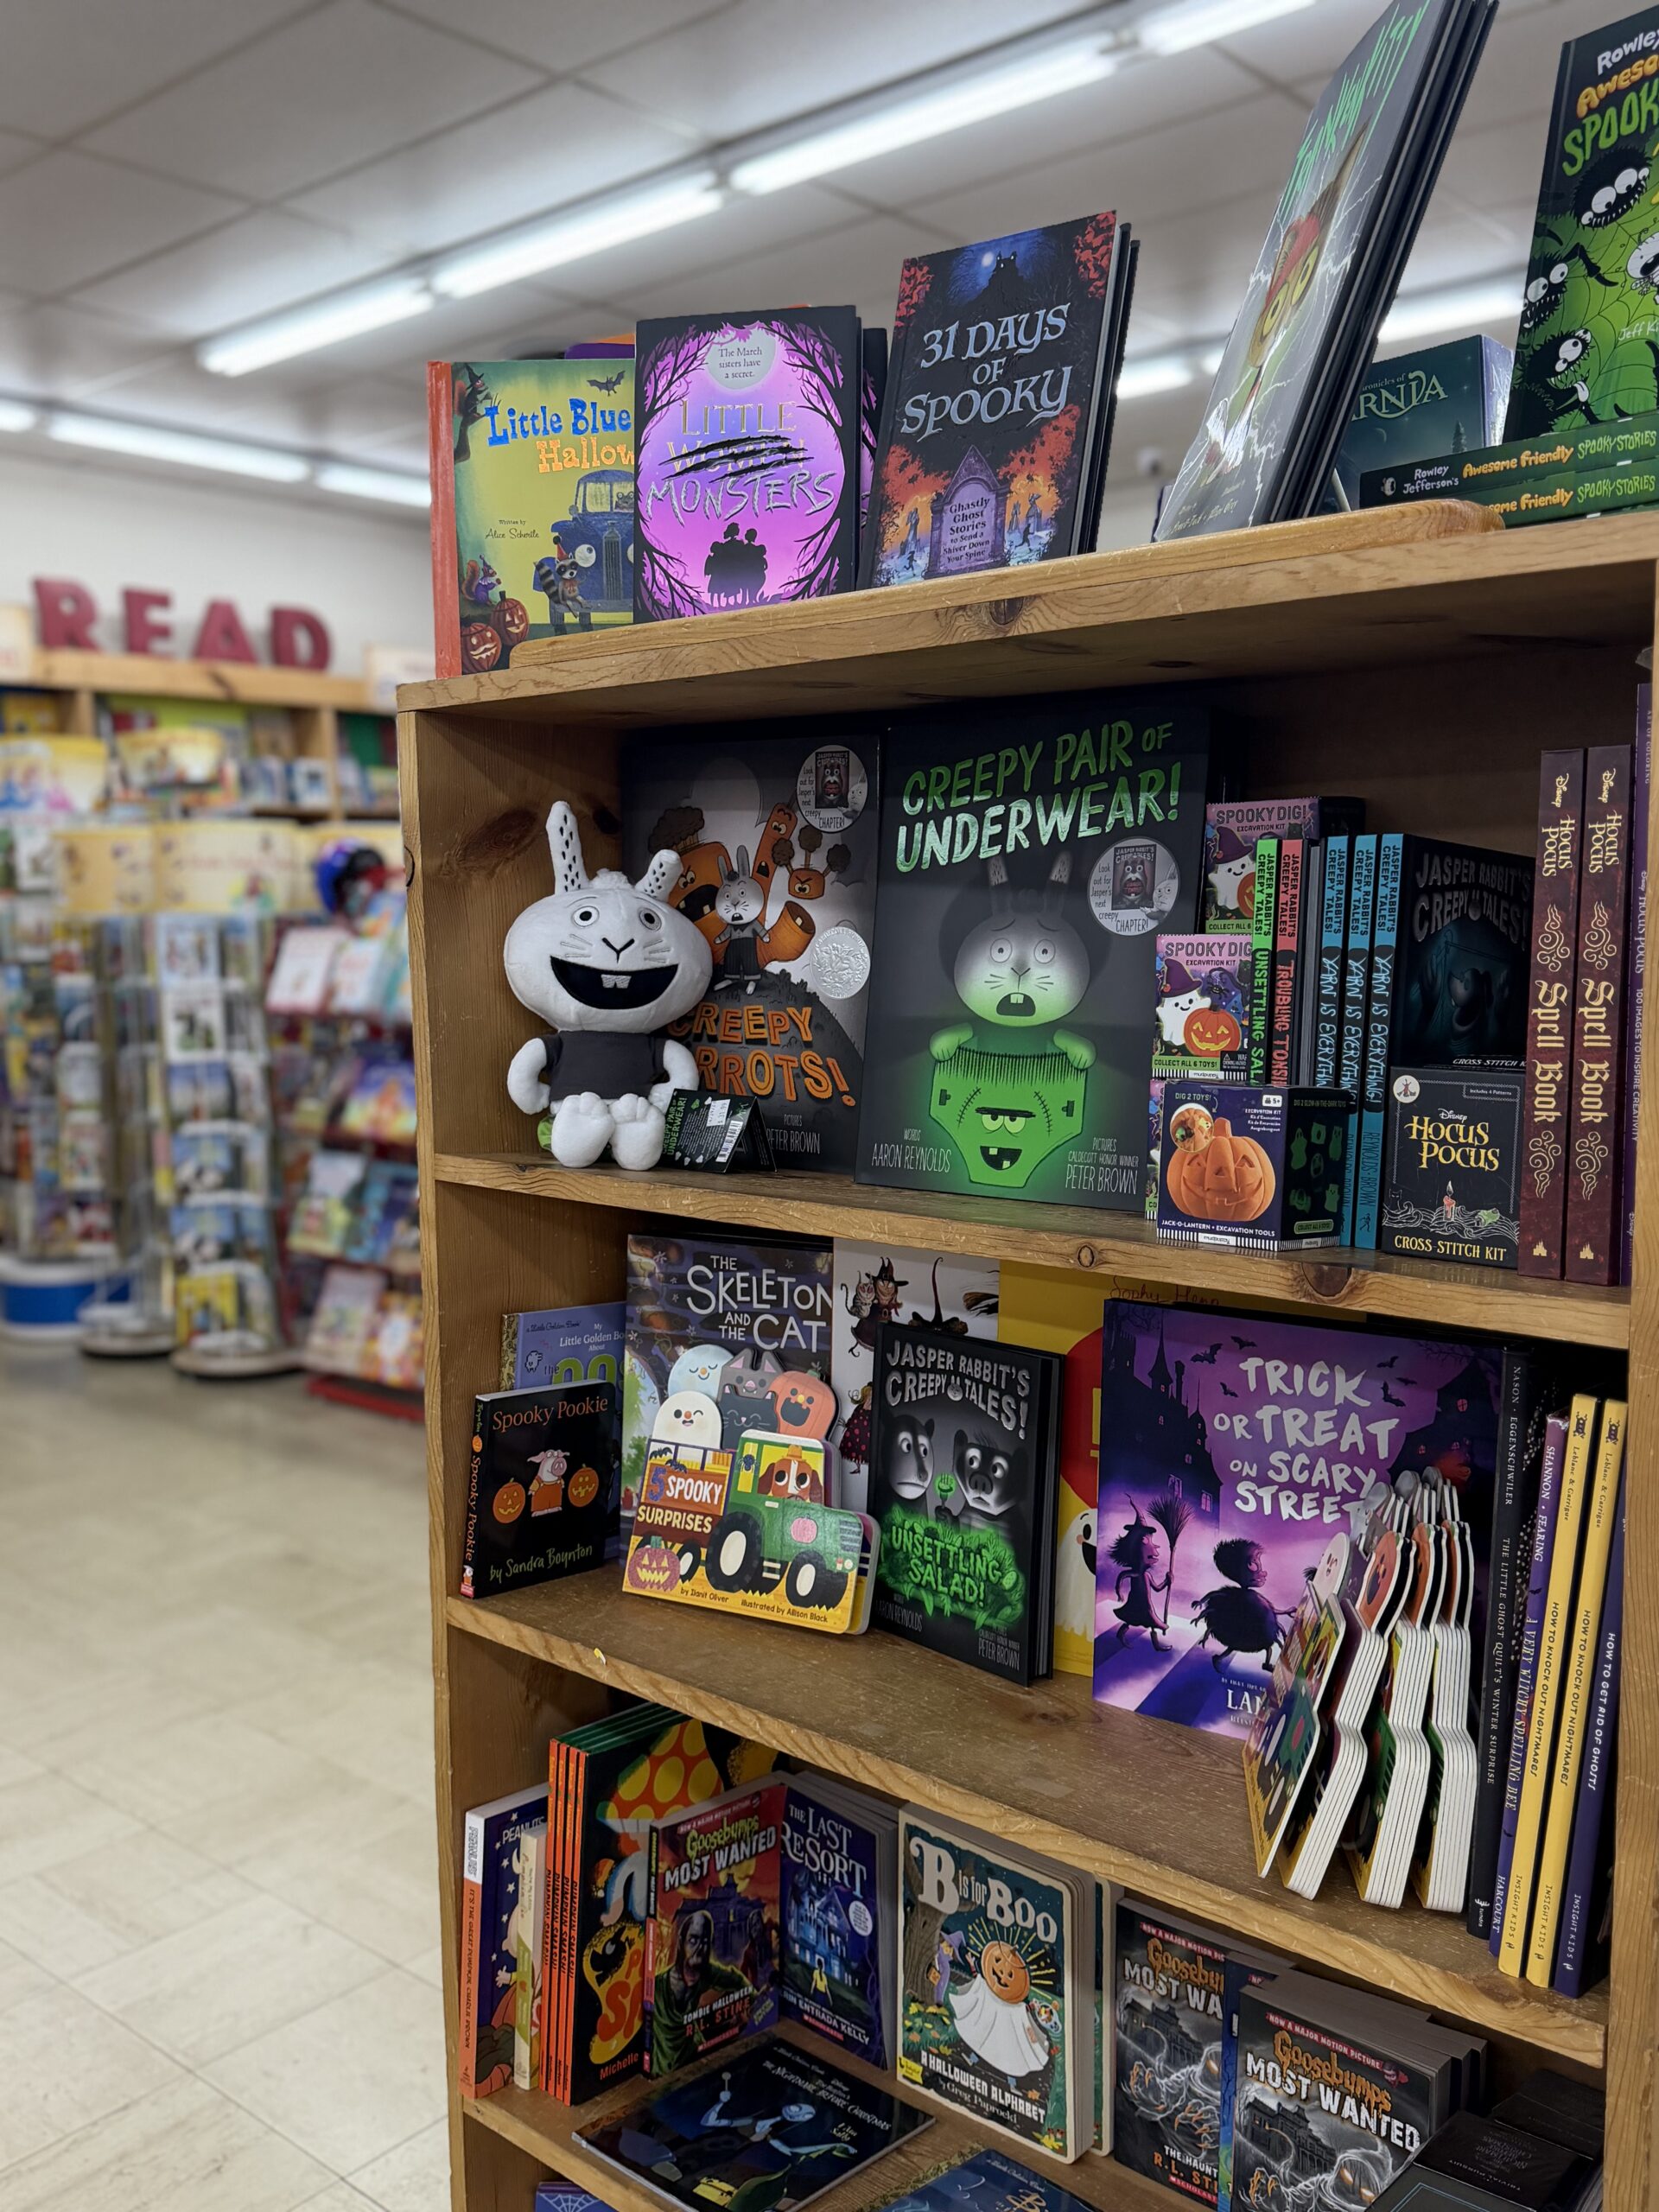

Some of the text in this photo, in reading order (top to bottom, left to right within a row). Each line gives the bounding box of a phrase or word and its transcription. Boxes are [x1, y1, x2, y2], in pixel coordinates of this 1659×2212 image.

[719, 347, 762, 357] The March
[920, 303, 1071, 369] 31 DAYS
[743, 359, 760, 367] have
[972, 357, 1007, 385] OF
[484, 397, 632, 447] Little Blue
[681, 400, 797, 435] LITTLE
[900, 365, 1072, 442] SPOOKY
[1414, 465, 1449, 480] Rowley
[1462, 430, 1657, 478] Awesome Friendly SPOOKY STORIES
[646, 470, 837, 528] MONSTERS
[950, 497, 990, 514] Ghastly
[1403, 477, 1459, 495] Jefferson's
[950, 520, 986, 535] Stories
[953, 510, 984, 524] Ghost
[944, 540, 989, 554] Shiver Down
[33, 575, 332, 671] READ
[902, 720, 1173, 816] CREEPY PAIR OF
[896, 761, 1181, 873] UNDERWEAR!
[1217, 804, 1307, 824] SPOOKY DIG!
[1236, 823, 1274, 832] EXCAVATION
[1098, 912, 1119, 922] creepy
[1255, 855, 1266, 936] CREEPY TALES!
[1263, 854, 1274, 937] JASPER RABBIT'S
[1116, 919, 1149, 932] CHAPTER!
[1166, 942, 1224, 957] SPOOKY
[1365, 954, 1393, 1103] YARN IS EVERYTHING!
[1531, 980, 1568, 1123] Spell Book
[1634, 1040, 1642, 1052] TO
[696, 1046, 855, 1106] RROTS!
[1632, 1054, 1642, 1089] INSPIRE
[1631, 1090, 1641, 1141] CREATIVITY
[872, 1143, 951, 1173] AARON REYNOLDS
[1065, 1164, 1138, 1196] PETER BROWN
[1068, 1150, 1139, 1167] CALDECOTT HONOR WINNER
[1361, 1132, 1381, 1208] REYNOLDS BROWN
[1161, 1219, 1211, 1231] JACK-O-LANTERN
[1217, 1226, 1254, 1236] EXCAVATION
[710, 1255, 737, 1270] THE
[687, 1265, 832, 1316] SKELETON
[719, 1314, 826, 1352] THE CAT
[724, 1312, 751, 1325] AND
[887, 1340, 1030, 1397] JASPER RABBIT'S
[1239, 1357, 1370, 1408] TRICK
[493, 1396, 608, 1432] Spooky Pookie
[886, 1370, 1029, 1440] CREEPY TALES!
[1214, 1406, 1400, 1459] OR TREAT
[1504, 1366, 1521, 1505] NASON EGGENSCHWILER
[648, 1466, 722, 1505] 5 SPOOKY
[1230, 1451, 1376, 1498] ON SCARY
[637, 1505, 713, 1534] SURPRISES
[1534, 1446, 1555, 1563] SHANNON FEARING
[490, 1543, 593, 1583] by Sandra Boynton
[892, 1525, 1002, 1584] UNSETTLING
[909, 1559, 985, 1607] SALAD!
[1499, 1563, 1509, 1599] LITTLE
[1497, 1603, 1506, 1638] GHOST
[1492, 1641, 1503, 1683] QUILT'S
[1491, 1688, 1501, 1731] WINTER
[1529, 1602, 1560, 1777] HOW TO KNOCK OUT NIGHTMARES
[1487, 1735, 1497, 1785] SURPRISE
[686, 1815, 760, 1861] Goosebumps
[789, 1804, 853, 1858] THE LAST
[665, 1855, 710, 1891] MOST
[715, 1826, 776, 1872] WANTED
[781, 1821, 867, 1899] RESORT
[910, 1836, 960, 1915] B
[971, 1876, 987, 1907] for
[1492, 1874, 1506, 1934] HARCOURT
[1508, 1874, 1522, 1939] INSIGHT KIDS
[1124, 1958, 1180, 2000] MOST
[683, 1986, 753, 2024] ZOMBIE HALLOWEEN
[1269, 2014, 1286, 2029] NOW
[1294, 2024, 1319, 2042] MAJOR
[1321, 2037, 1348, 2056] MOTION
[1350, 2049, 1381, 2070] PICTURE
[600, 2053, 639, 2081] Michelle
[921, 2050, 928, 2066] A
[929, 2054, 988, 2095] HALLOWEEN
[991, 2083, 1046, 2124] ALPHABET
[1274, 2030, 1392, 2114] Goosebumps
[947, 2083, 971, 2103] Greg
[1246, 2052, 1313, 2101] MOST
[1319, 2082, 1421, 2152] WANTED
[1448, 2158, 1522, 2191] TRIVIAL PURSUIT
